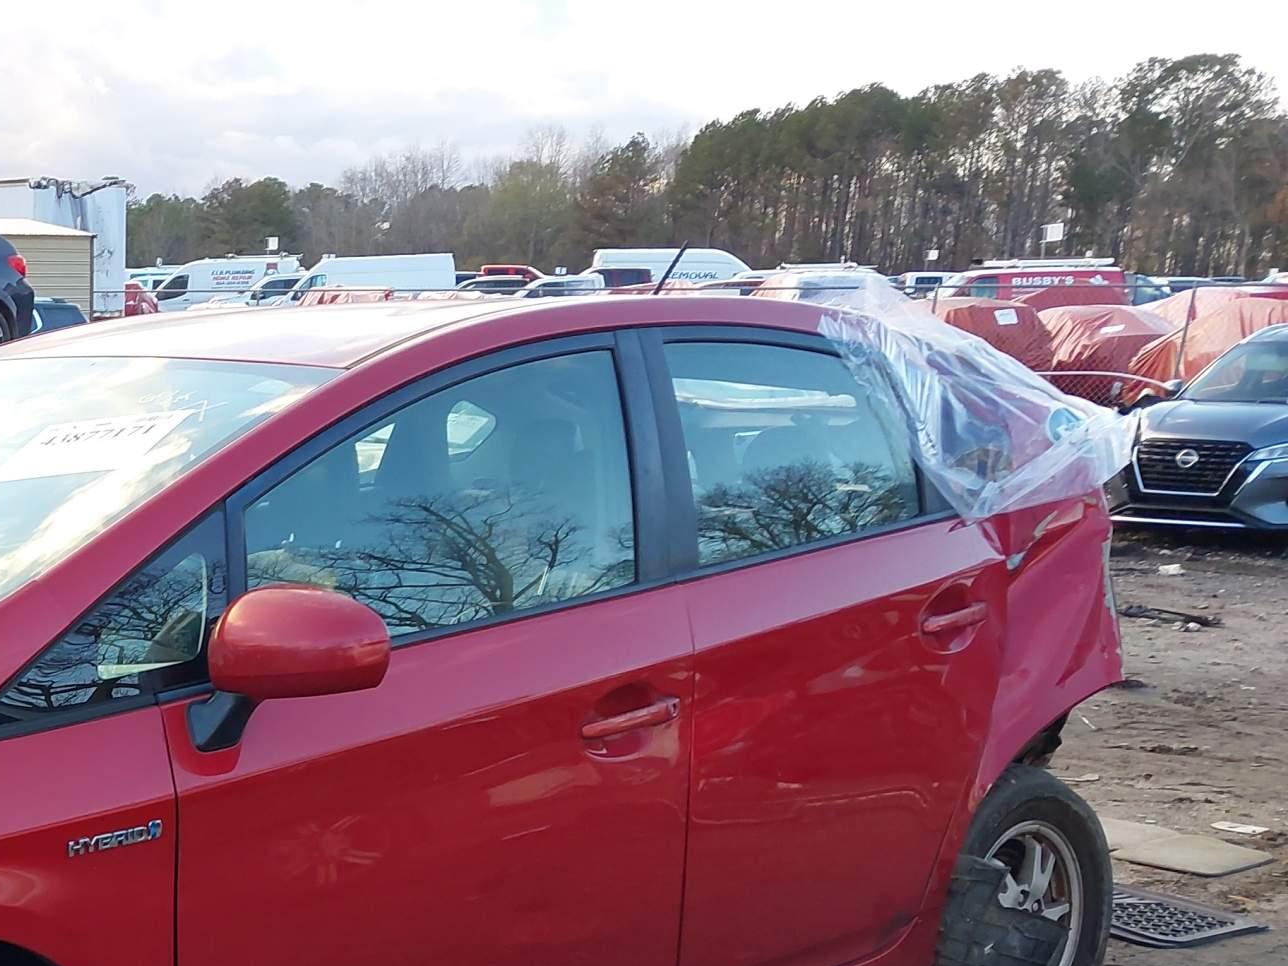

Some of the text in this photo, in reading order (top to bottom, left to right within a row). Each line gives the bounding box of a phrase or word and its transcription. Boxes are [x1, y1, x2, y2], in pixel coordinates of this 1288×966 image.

[668, 271, 719, 280] EMOVAL
[1011, 275, 1075, 287] BUSBY'S
[68, 826, 148, 857] HYBRID
